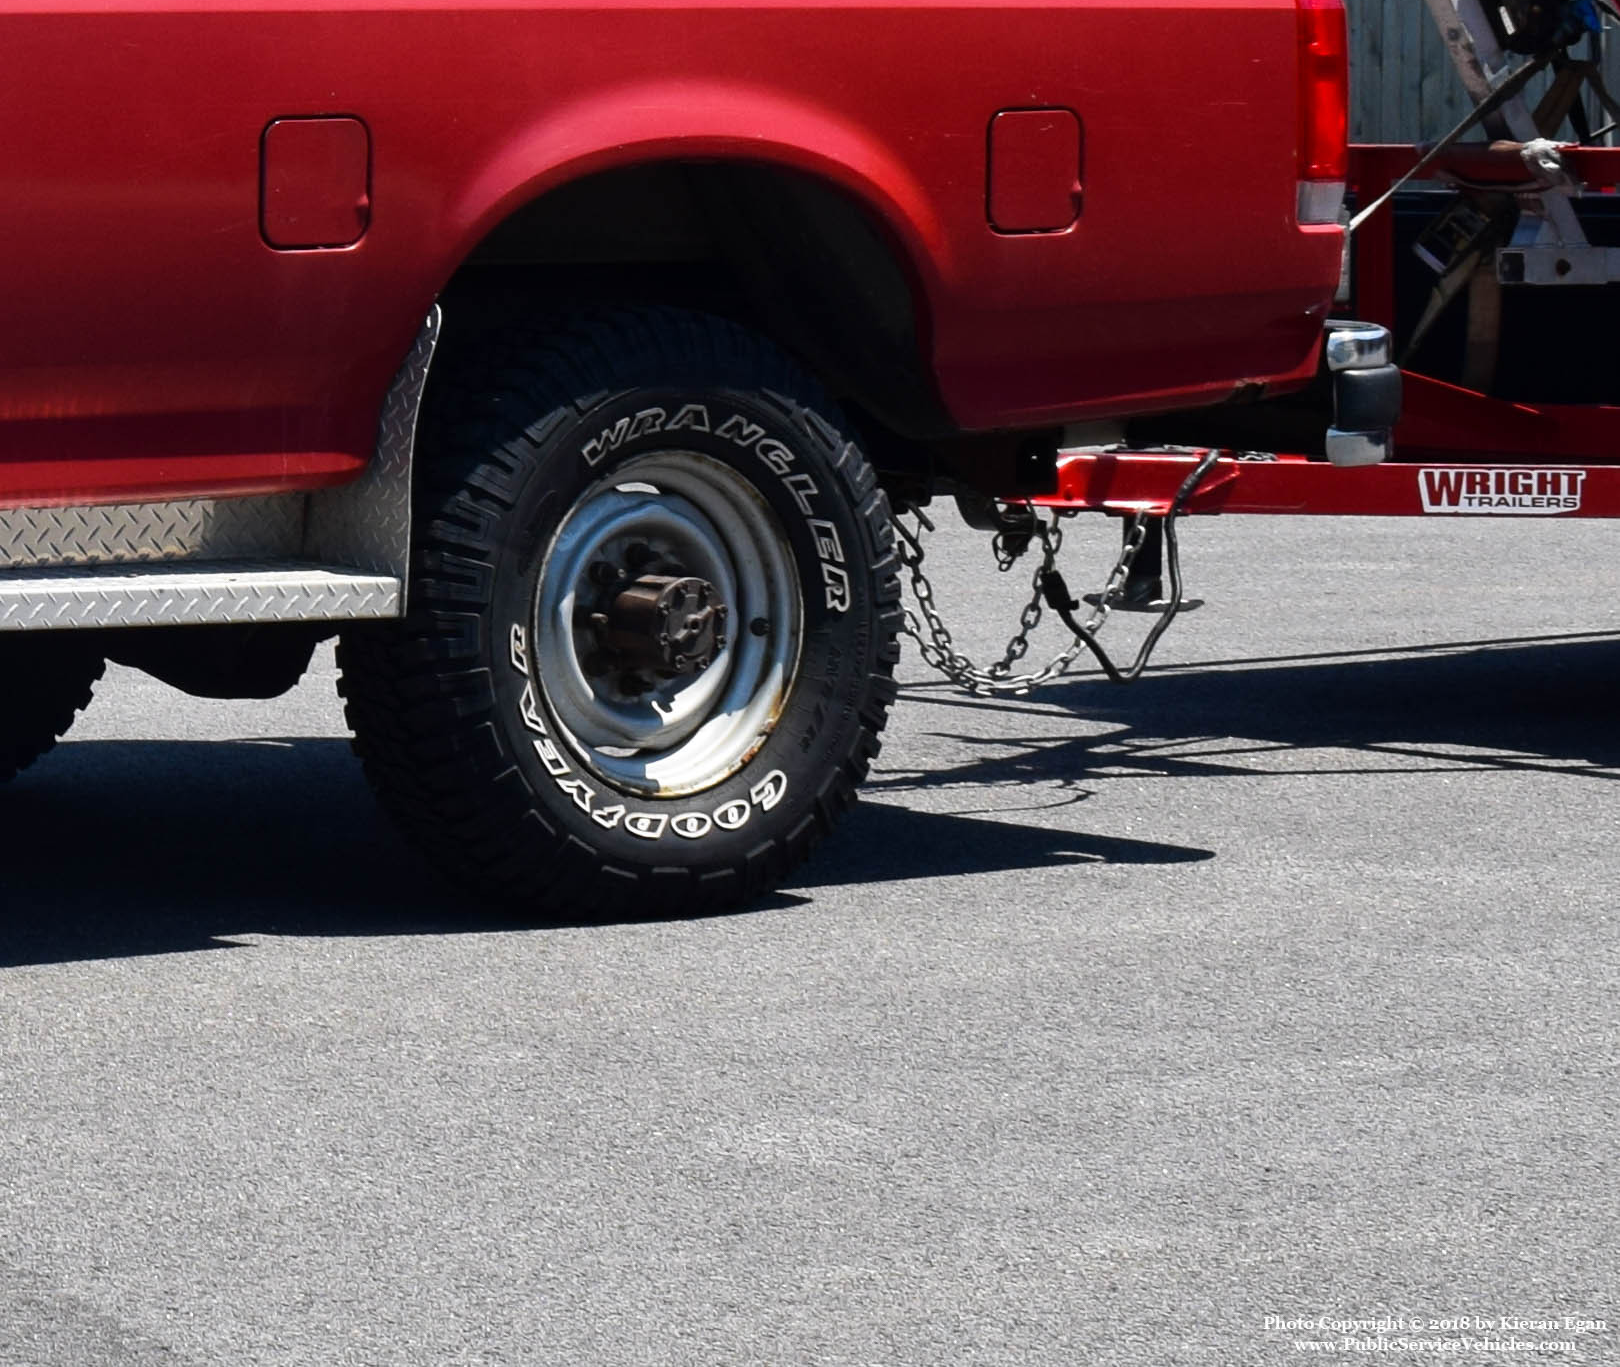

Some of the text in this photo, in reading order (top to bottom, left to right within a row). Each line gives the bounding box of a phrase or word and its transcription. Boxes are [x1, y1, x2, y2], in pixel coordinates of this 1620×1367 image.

[582, 404, 851, 613] WRANGLER
[1423, 471, 1584, 507] WRIGHT
[1463, 496, 1578, 508] TRAILERS
[511, 623, 788, 839] GOODYEAR
